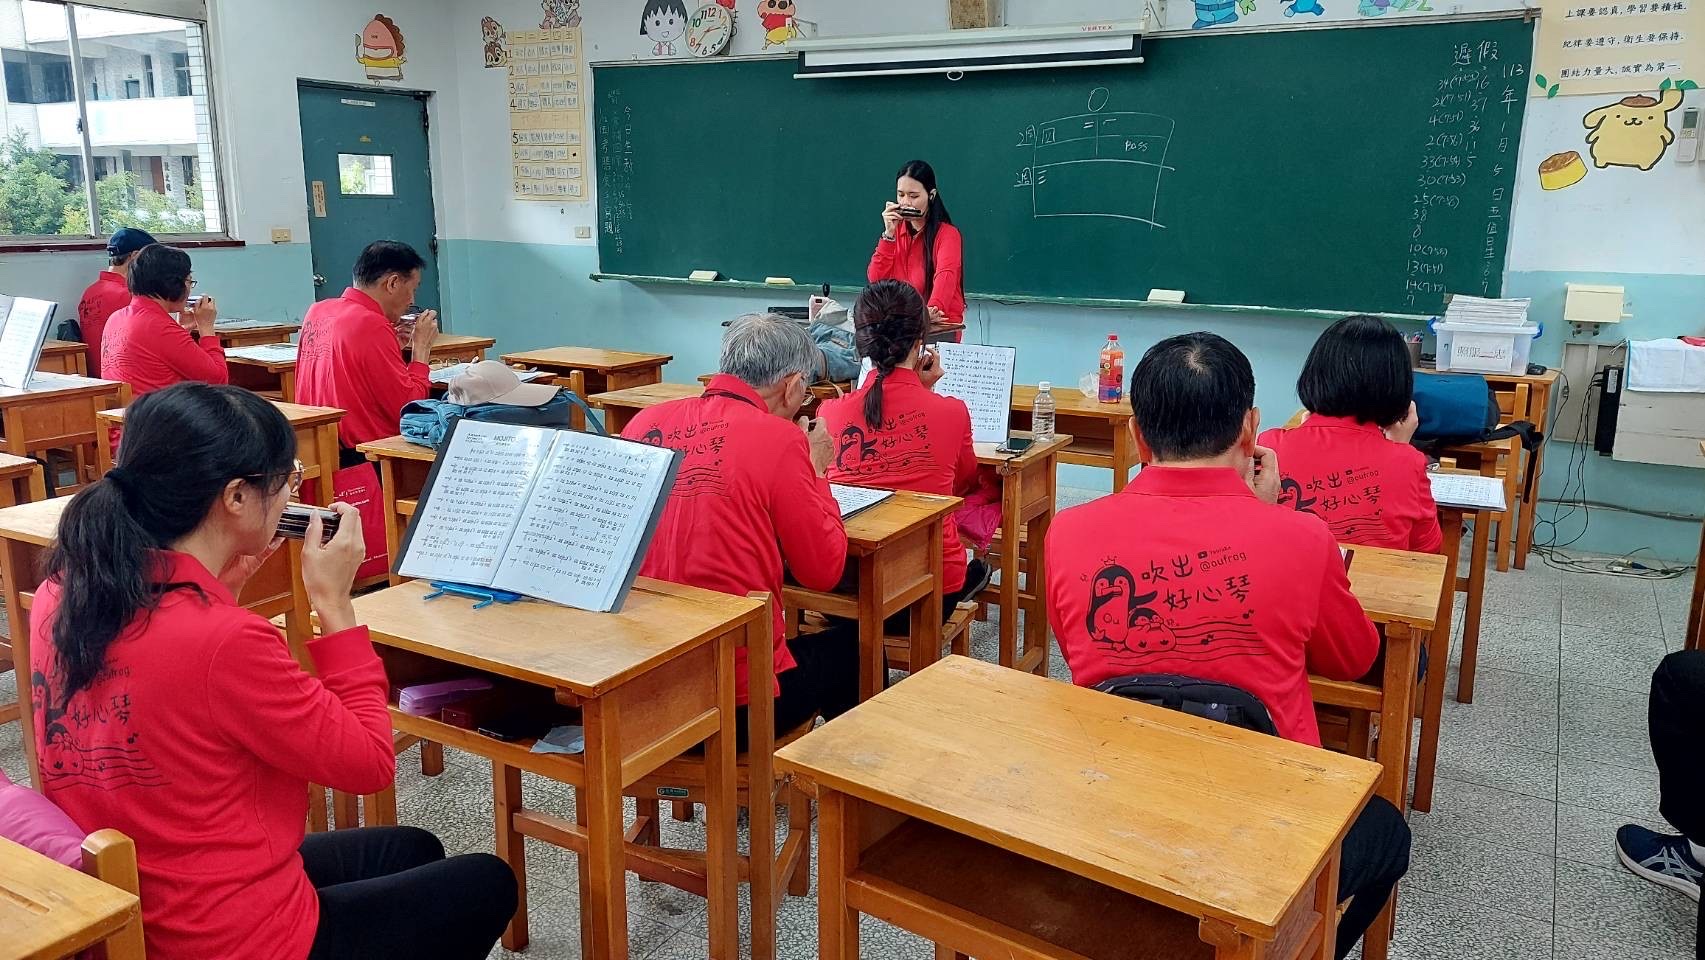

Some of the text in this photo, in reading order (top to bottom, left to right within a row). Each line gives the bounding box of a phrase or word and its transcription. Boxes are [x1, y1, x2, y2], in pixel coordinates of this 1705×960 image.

[700, 9, 707, 20] 11
[707, 7, 717, 18] 12
[692, 18, 701, 28] 10
[720, 16, 727, 26] 2
[1081, 24, 1113, 32] VERTEX
[689, 37, 696, 47] 8
[701, 46, 708, 55] 6
[508, 65, 515, 76] 2
[509, 82, 516, 95] 3
[509, 98, 518, 111] 4
[512, 131, 519, 145] 5
[1467, 155, 1478, 168] 5
[667, 424, 697, 443] 吹出
[881, 424, 929, 450] 好心琴
[1306, 472, 1343, 492] 吹出
[1320, 485, 1382, 511] 好心琴
[1141, 554, 1194, 584] 吹出
[1162, 574, 1252, 612] 好心琴
[72, 694, 132, 729] 好心琴
